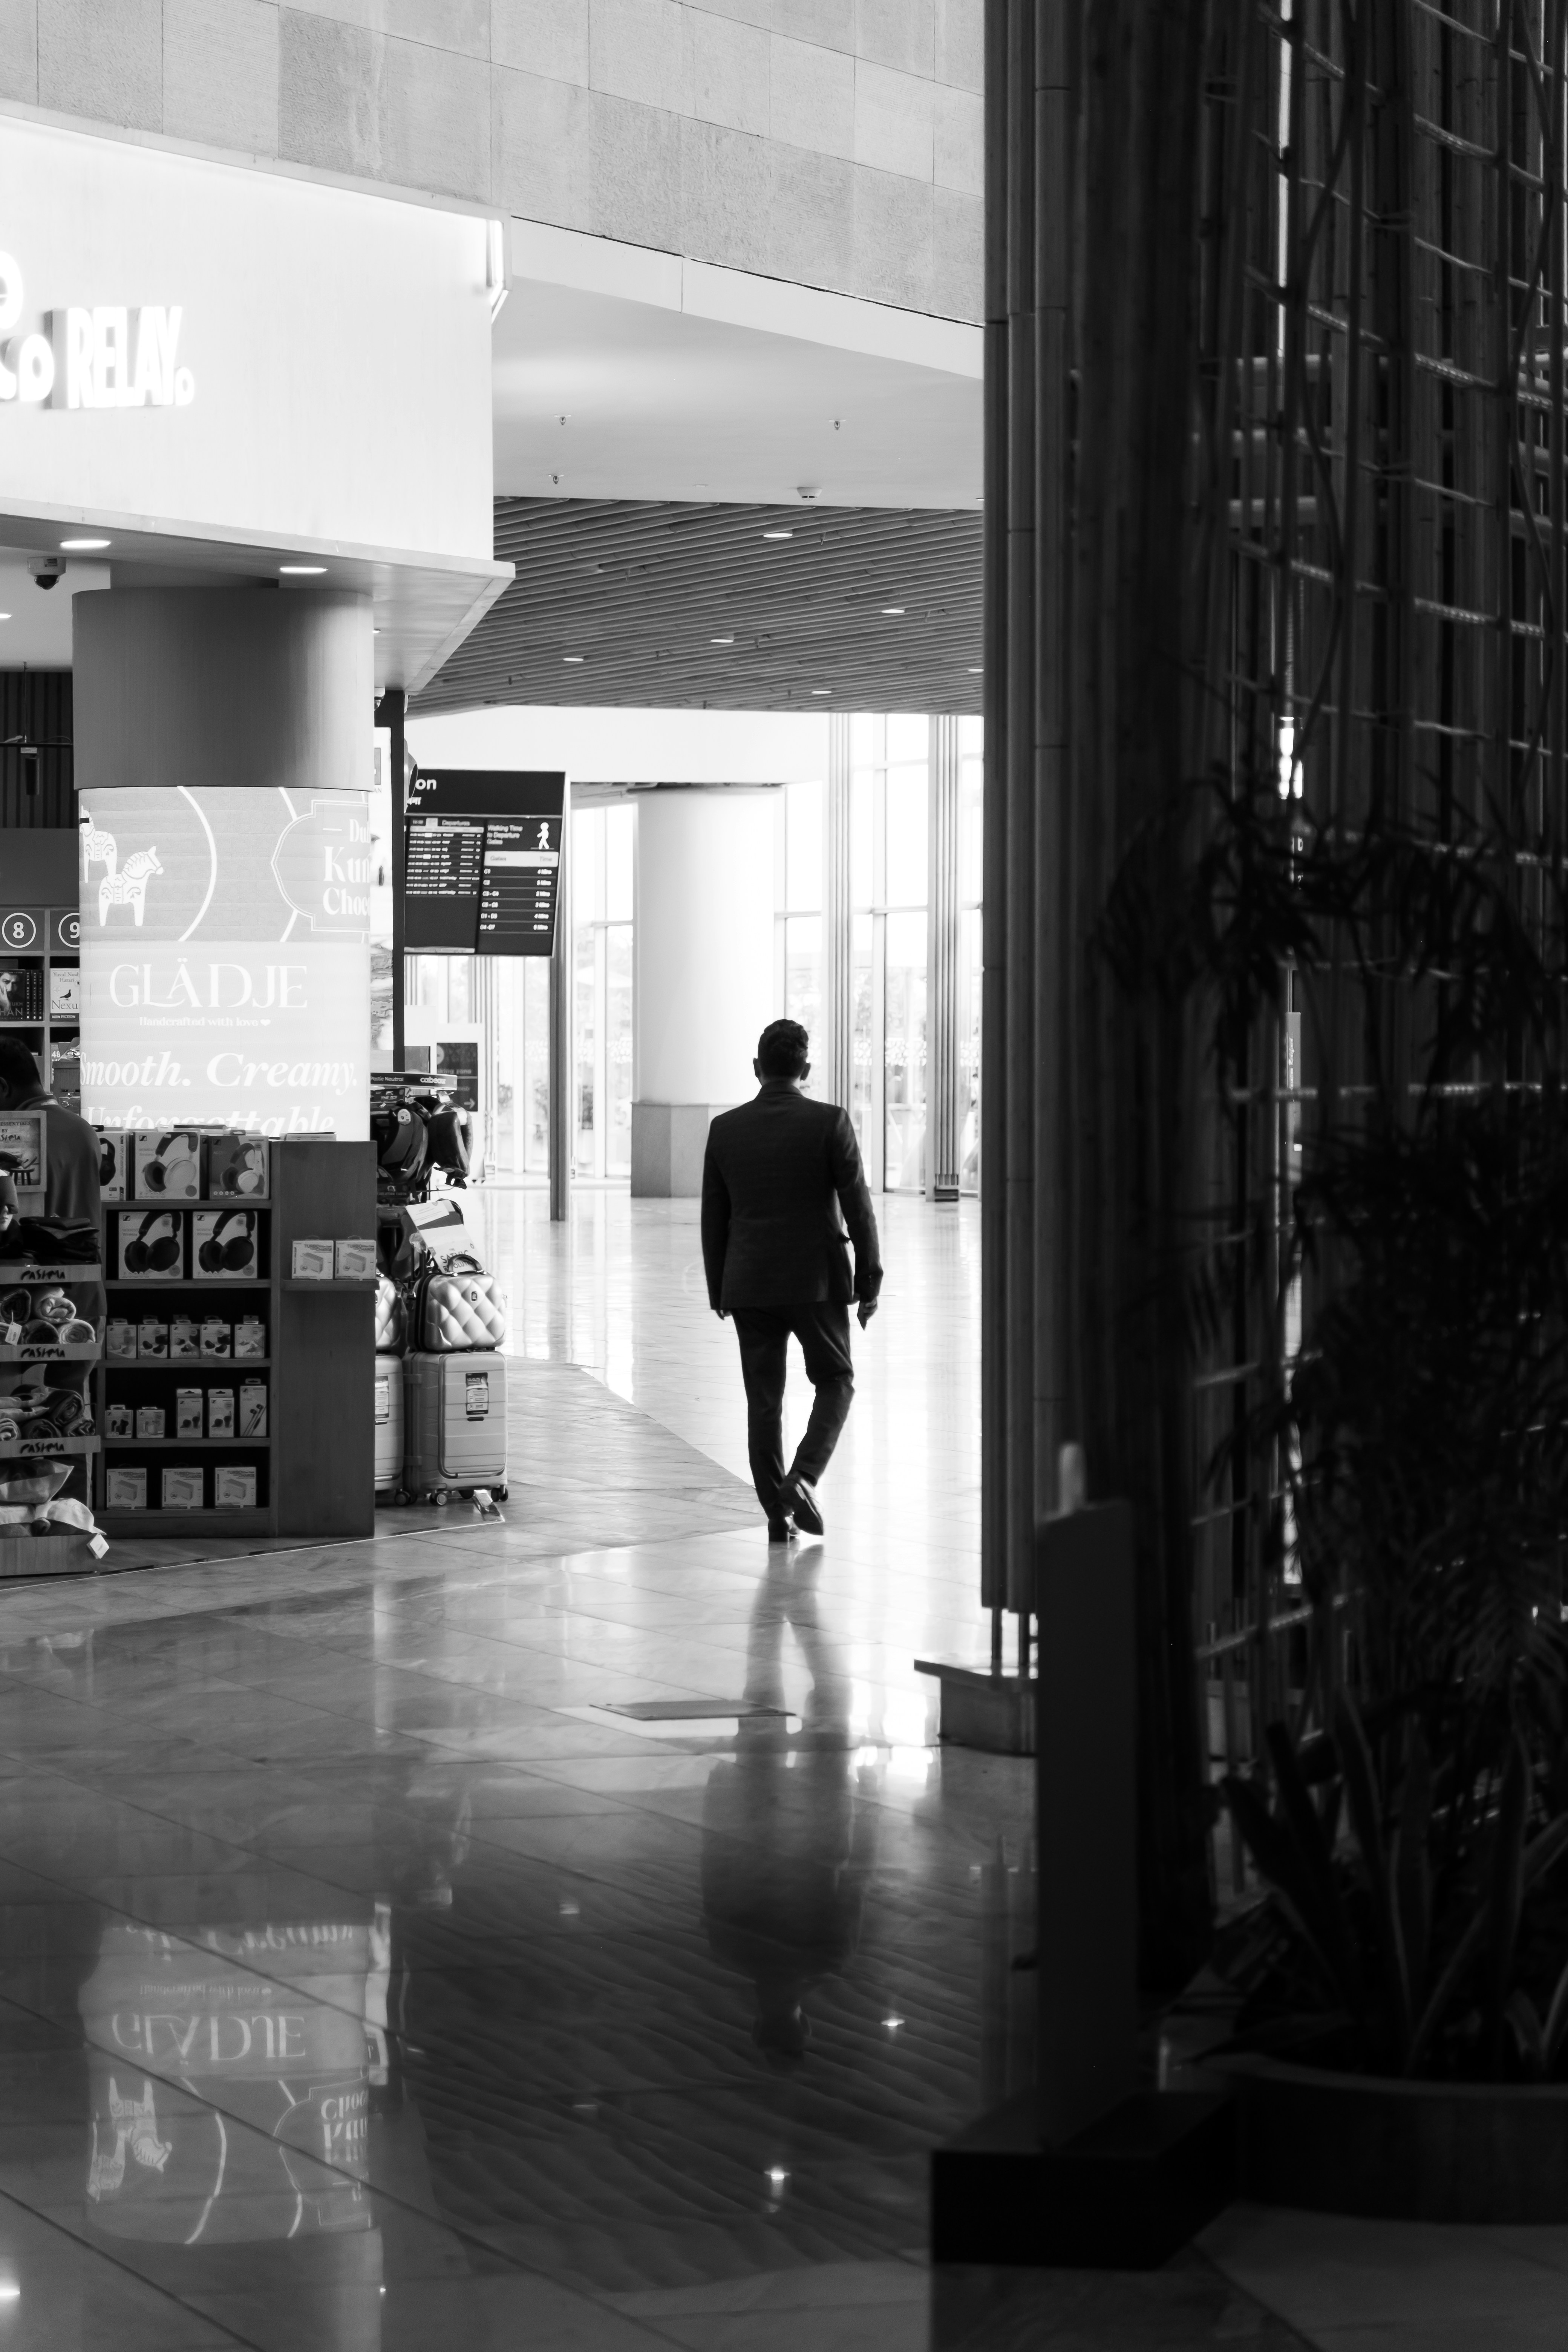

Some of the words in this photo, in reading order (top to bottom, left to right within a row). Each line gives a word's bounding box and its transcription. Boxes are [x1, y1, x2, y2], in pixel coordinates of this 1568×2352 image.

[13, 922, 24, 939] 8
[70, 922, 80, 939] 9
[110, 958, 308, 1008] GLÄDJE
[139, 1016, 205, 1026] Handcrafted
[208, 1016, 233, 1026] with
[236, 1016, 259, 1027] love
[80, 1051, 191, 1087] Smooth.
[207, 1052, 358, 1095] Creamy.
